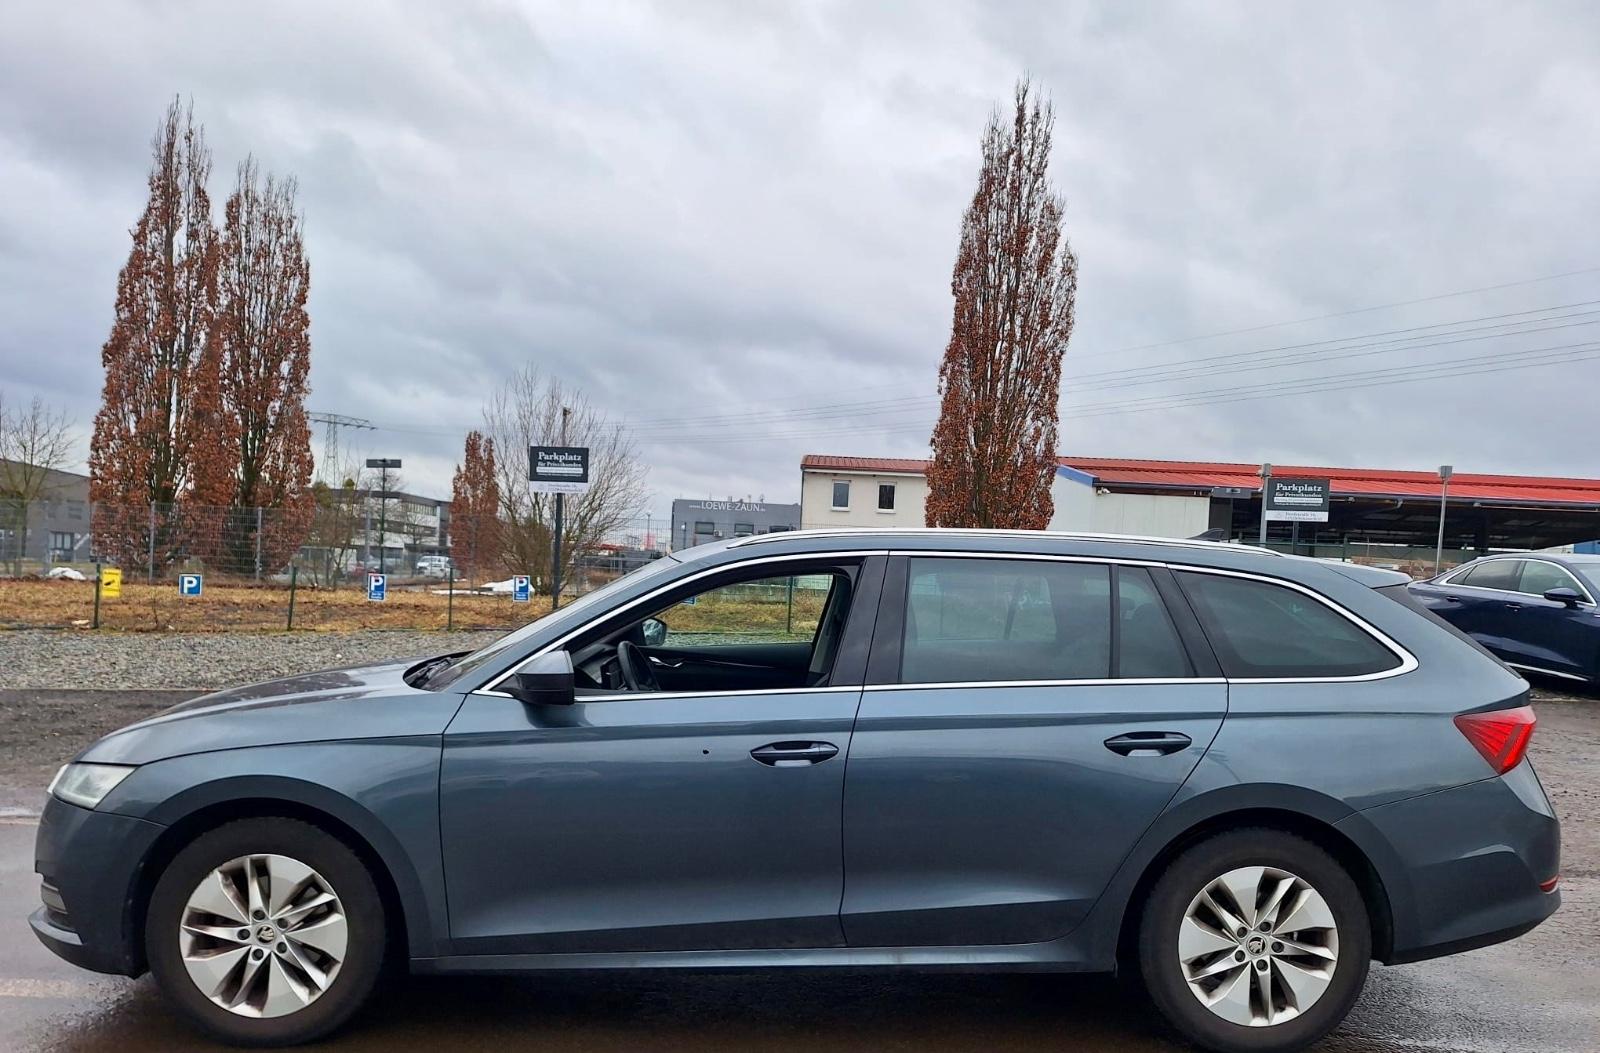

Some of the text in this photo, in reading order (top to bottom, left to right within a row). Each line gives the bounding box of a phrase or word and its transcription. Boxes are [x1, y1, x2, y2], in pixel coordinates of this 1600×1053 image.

[538, 451, 582, 462] Parkplatz
[1275, 483, 1322, 493] Parkplatz
[183, 576, 197, 594] P
[370, 575, 384, 591] P
[515, 576, 528, 592] P
